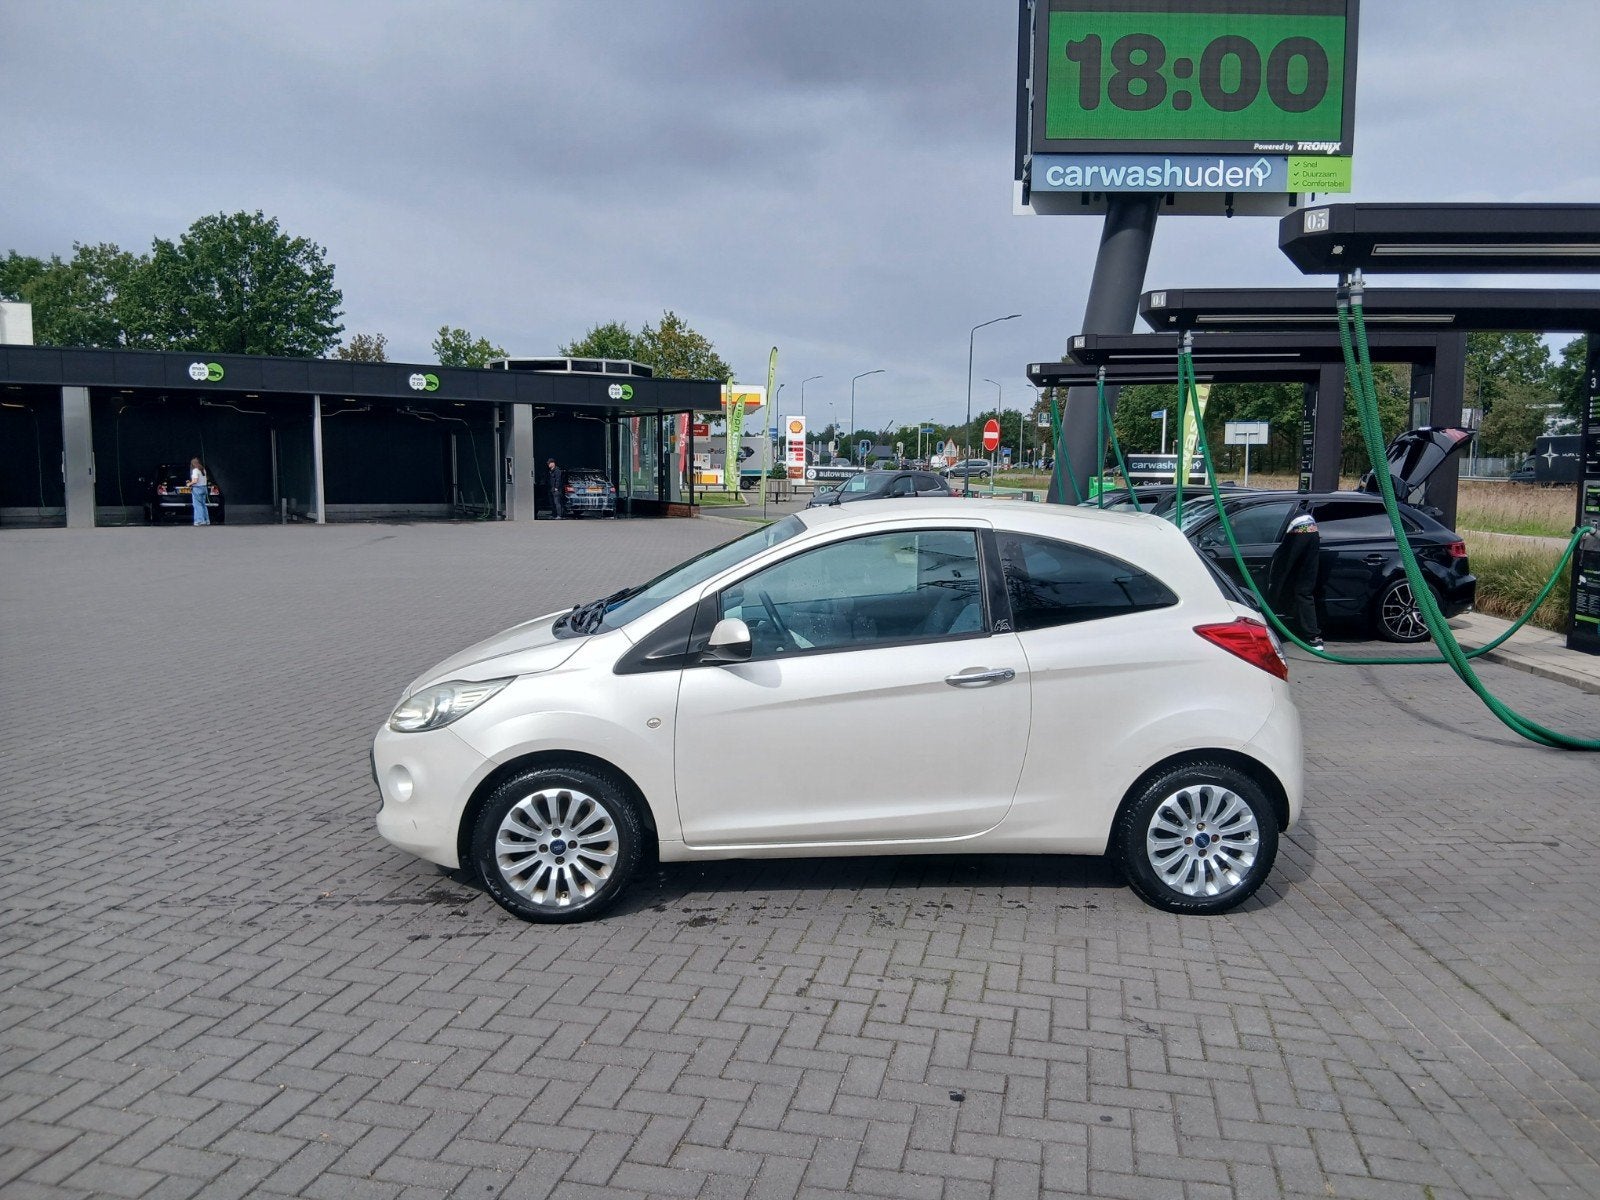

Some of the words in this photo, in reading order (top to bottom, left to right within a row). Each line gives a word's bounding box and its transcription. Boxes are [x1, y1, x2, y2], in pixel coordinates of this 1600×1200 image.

[1066, 33, 1329, 113] 18:00
[1253, 143, 1283, 151] Powered
[1284, 143, 1294, 151] by
[1046, 158, 1267, 188] carwashuden
[1307, 212, 1326, 230] 05
[1590, 377, 1597, 388] 3
